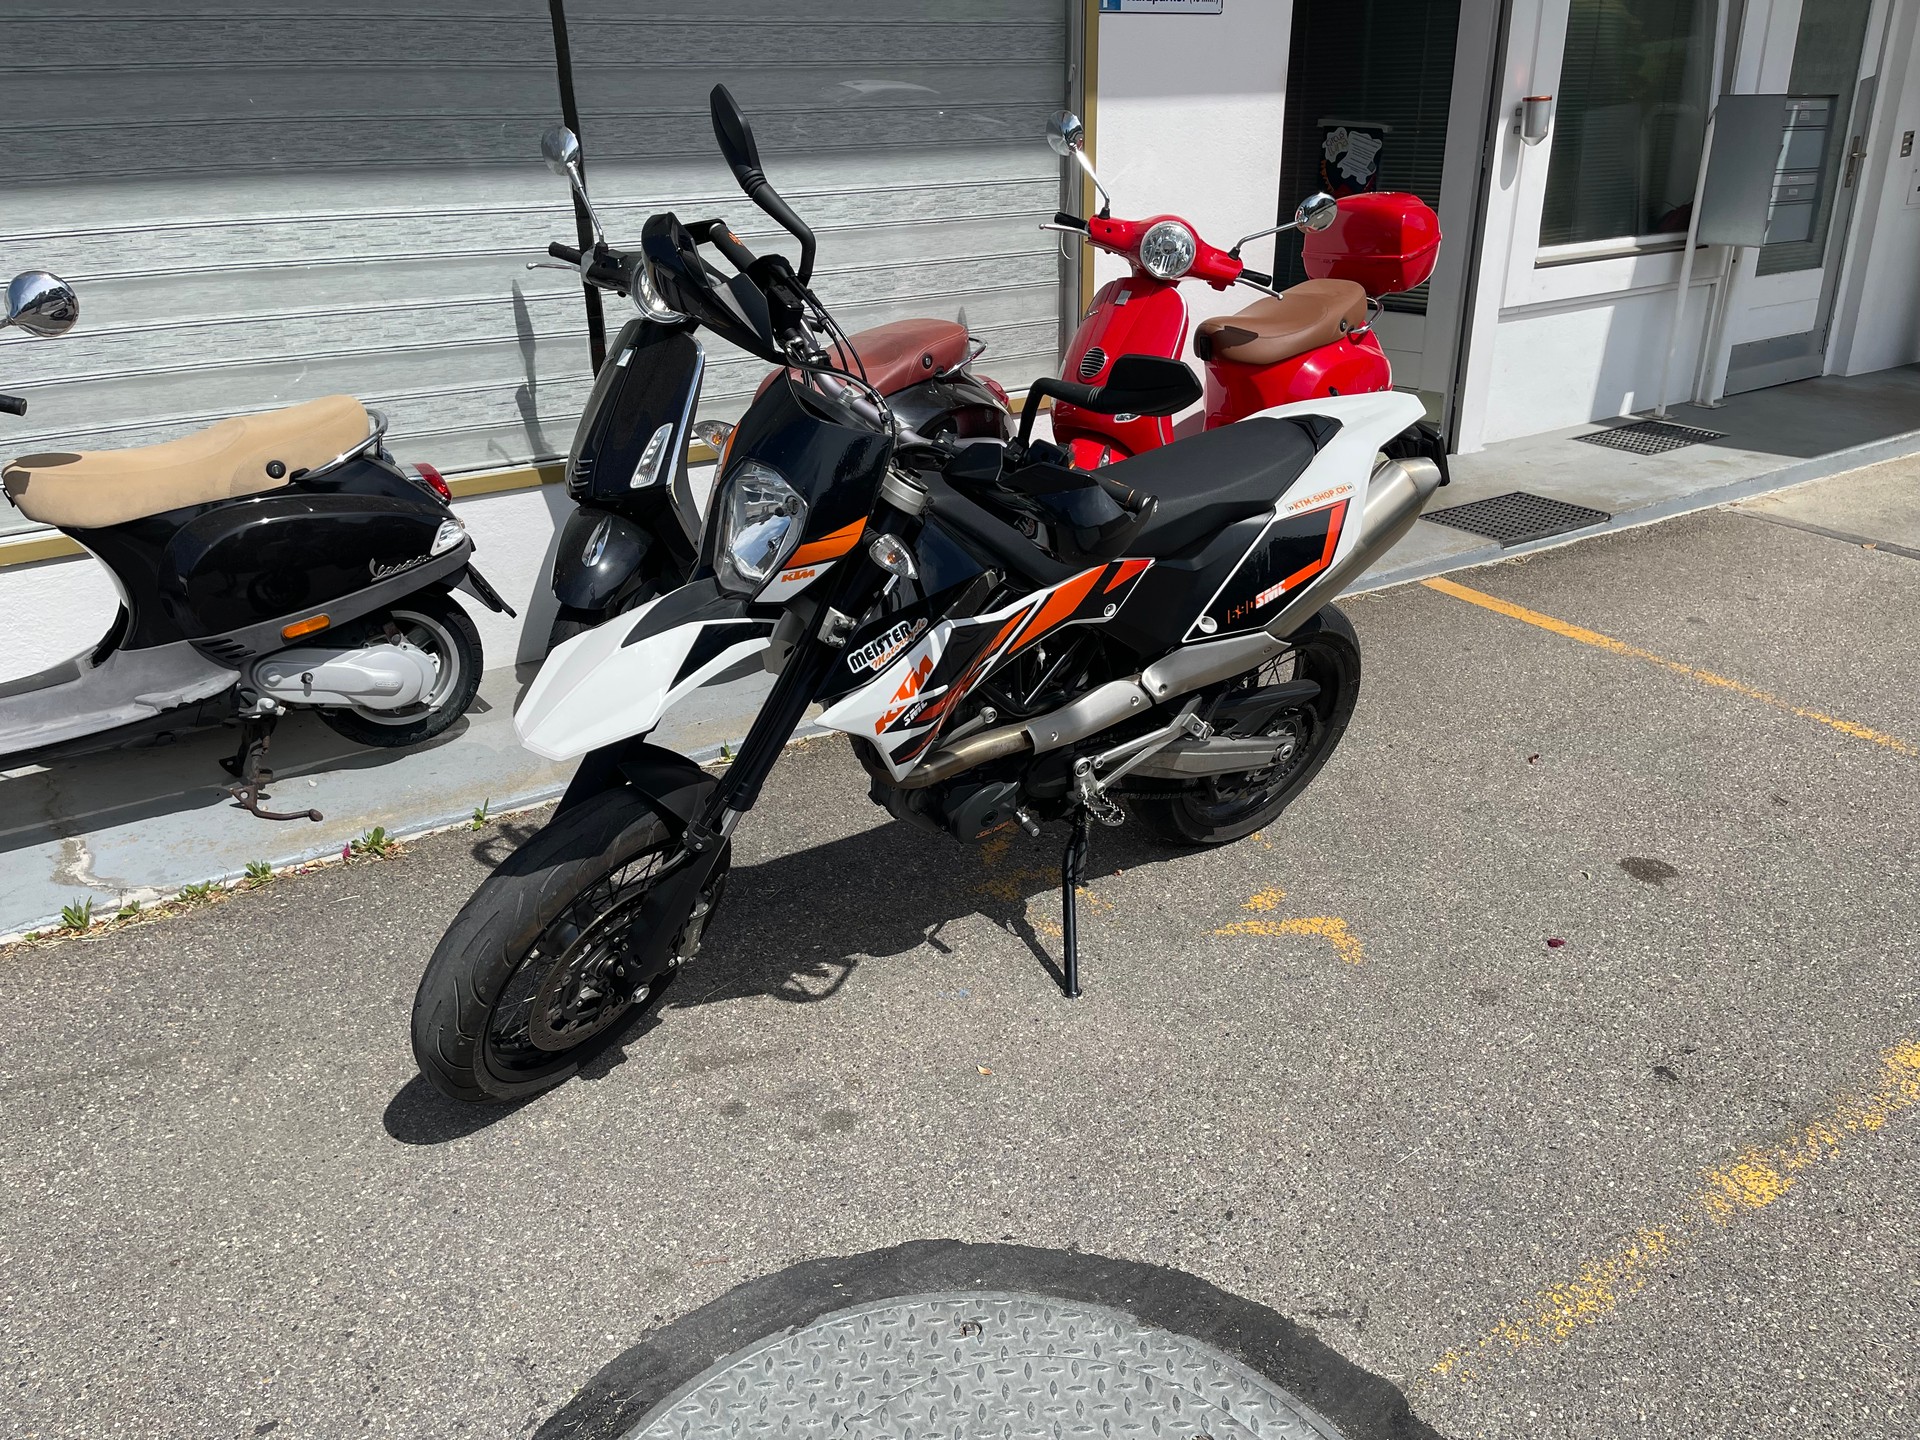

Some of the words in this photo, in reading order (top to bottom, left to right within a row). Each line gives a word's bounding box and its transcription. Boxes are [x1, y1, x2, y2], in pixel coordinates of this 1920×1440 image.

[369, 555, 433, 582] Vespa
[781, 568, 815, 583] KTM
[849, 623, 911, 671] MEISTER
[871, 620, 926, 669] Motorcycle
[874, 654, 934, 736] KTM
